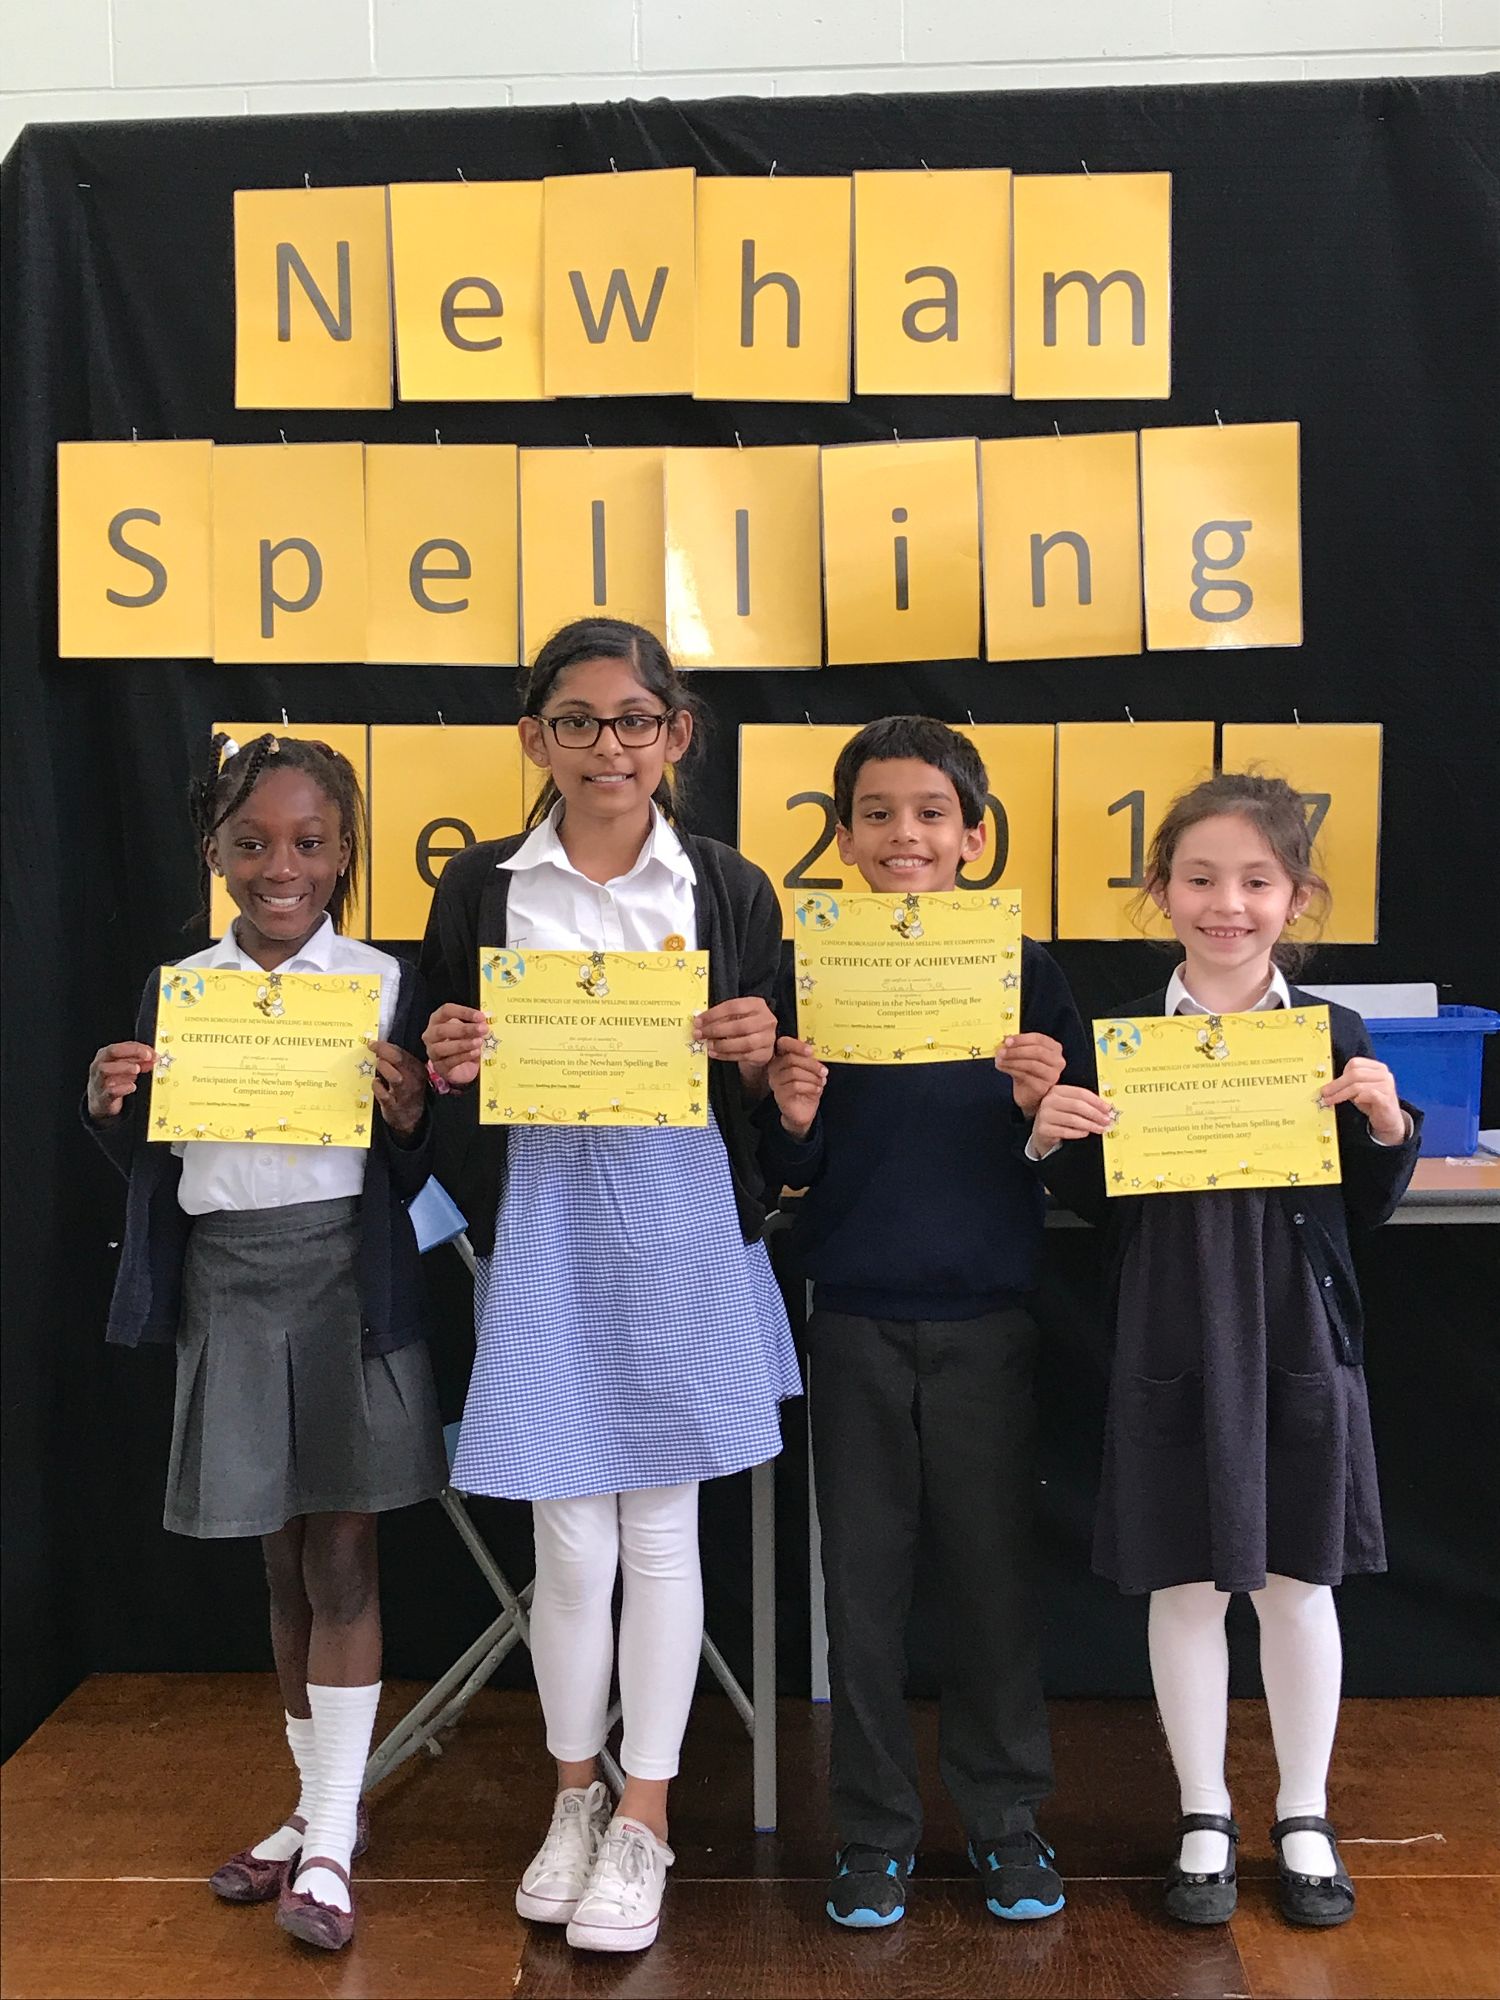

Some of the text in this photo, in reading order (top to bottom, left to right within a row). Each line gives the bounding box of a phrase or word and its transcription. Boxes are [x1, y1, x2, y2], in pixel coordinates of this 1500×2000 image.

[276, 239, 1146, 351] Newham
[105, 500, 1253, 639] Spelling
[820, 954, 997, 967] CERTIFICATE OF ACHIEVEMENT
[835, 996, 982, 1009] Participation in the Newham Spelling Bee
[876, 1008, 923, 1019] Competition
[505, 1014, 684, 1027] CERTIFICATE OF ACHIEVEMENT
[181, 1033, 355, 1049] CERTIFICATE OF ACHIEVEMENT
[519, 1057, 566, 1068] Participation
[567, 1059, 574, 1067] in
[575, 1059, 588, 1067] the
[590, 1059, 622, 1068] Newham
[623, 1059, 653, 1070] Spelling
[561, 1068, 608, 1078] Competition
[192, 1075, 338, 1090] Participation in the Newham Spelling Bee
[1124, 1074, 1308, 1095] CERTIFICATE OF ACHIEVEMENT
[233, 1087, 278, 1097] Competition
[1142, 1117, 1296, 1135] Participation in the Newham Spelling Bee
[1186, 1132, 1234, 1143] Competition
